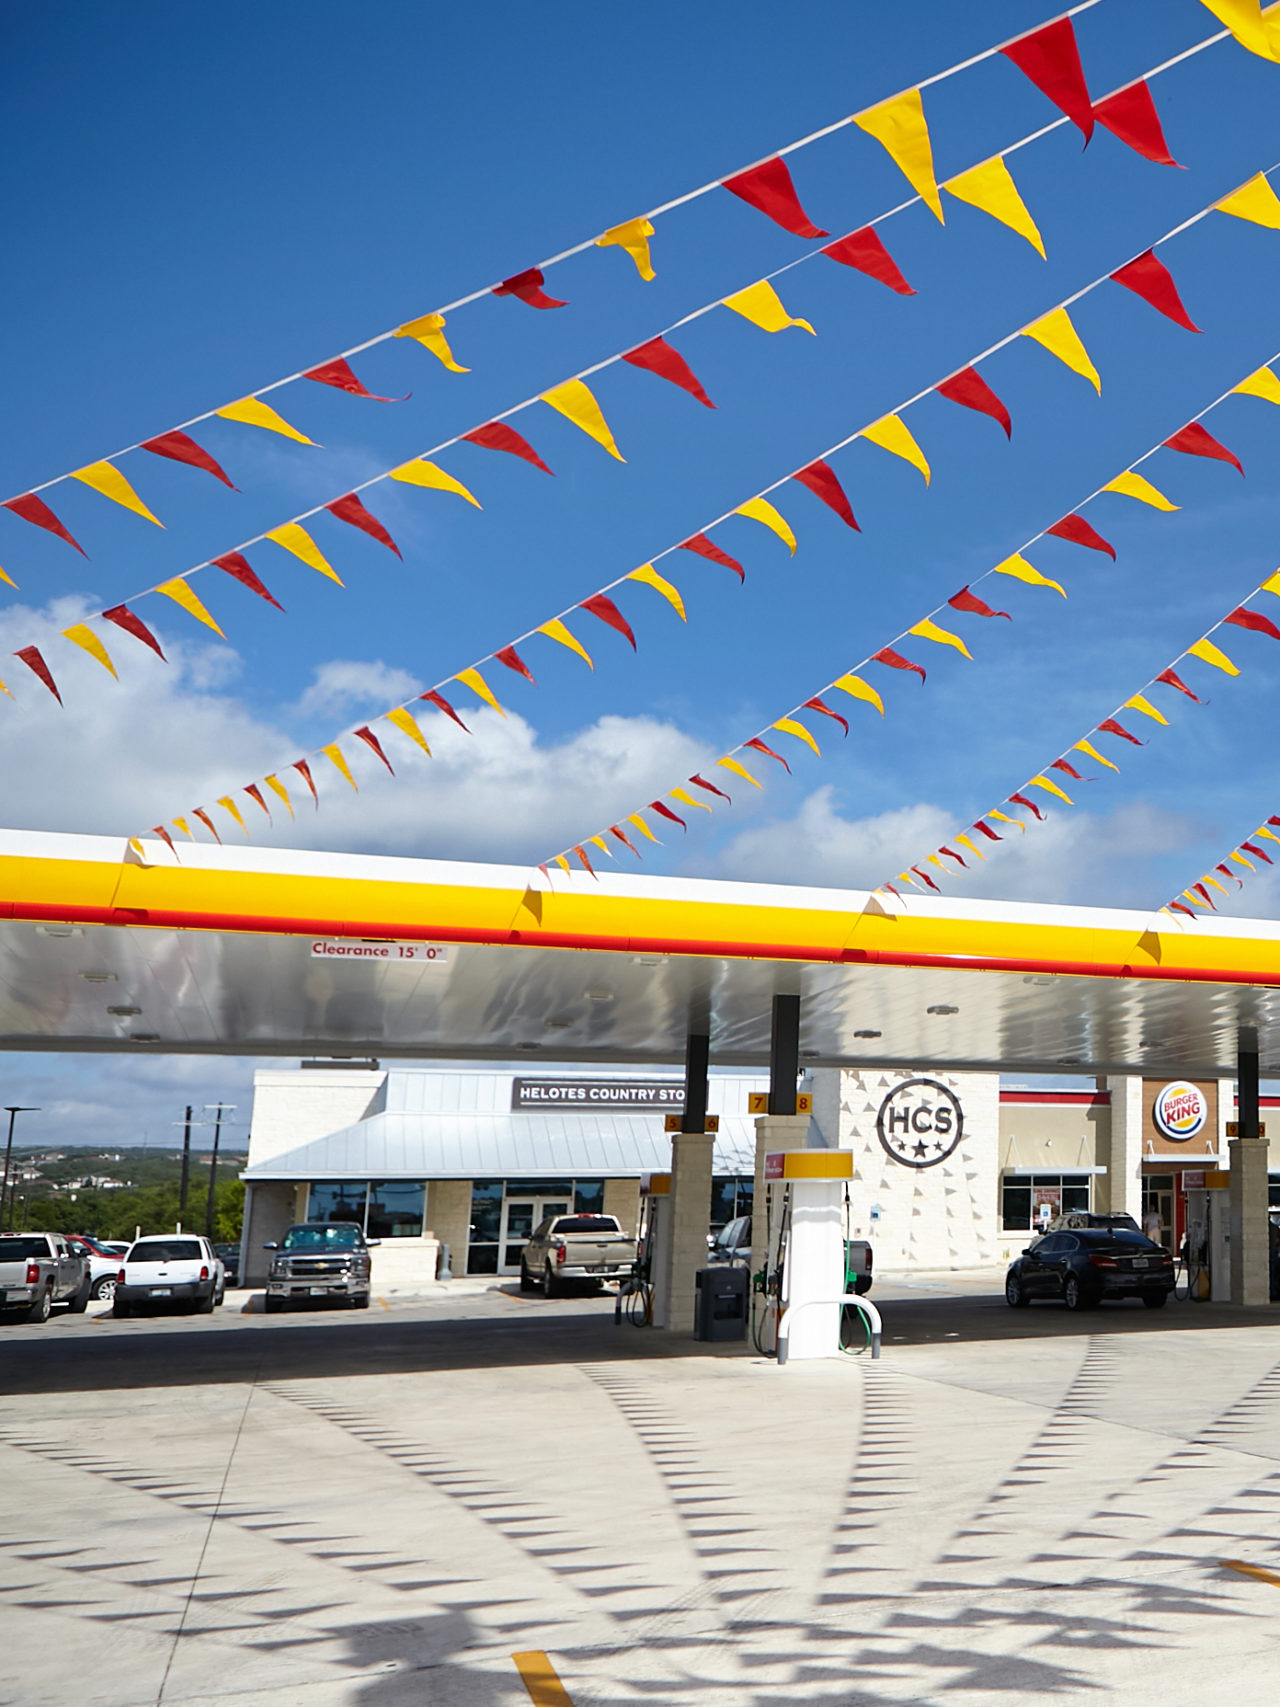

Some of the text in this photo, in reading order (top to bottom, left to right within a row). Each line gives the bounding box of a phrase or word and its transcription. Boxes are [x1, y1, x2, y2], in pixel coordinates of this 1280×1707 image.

[312, 942, 389, 957] Clearance
[520, 1087, 686, 1101] HELOTES COUNTRY STO
[754, 1097, 763, 1109] 7
[798, 1097, 808, 1110] 8
[1164, 1093, 1198, 1113] BURGER
[888, 1106, 953, 1134] HCS
[1166, 1102, 1200, 1125] KING
[669, 1118, 677, 1128] 5
[707, 1118, 716, 1128] 6
